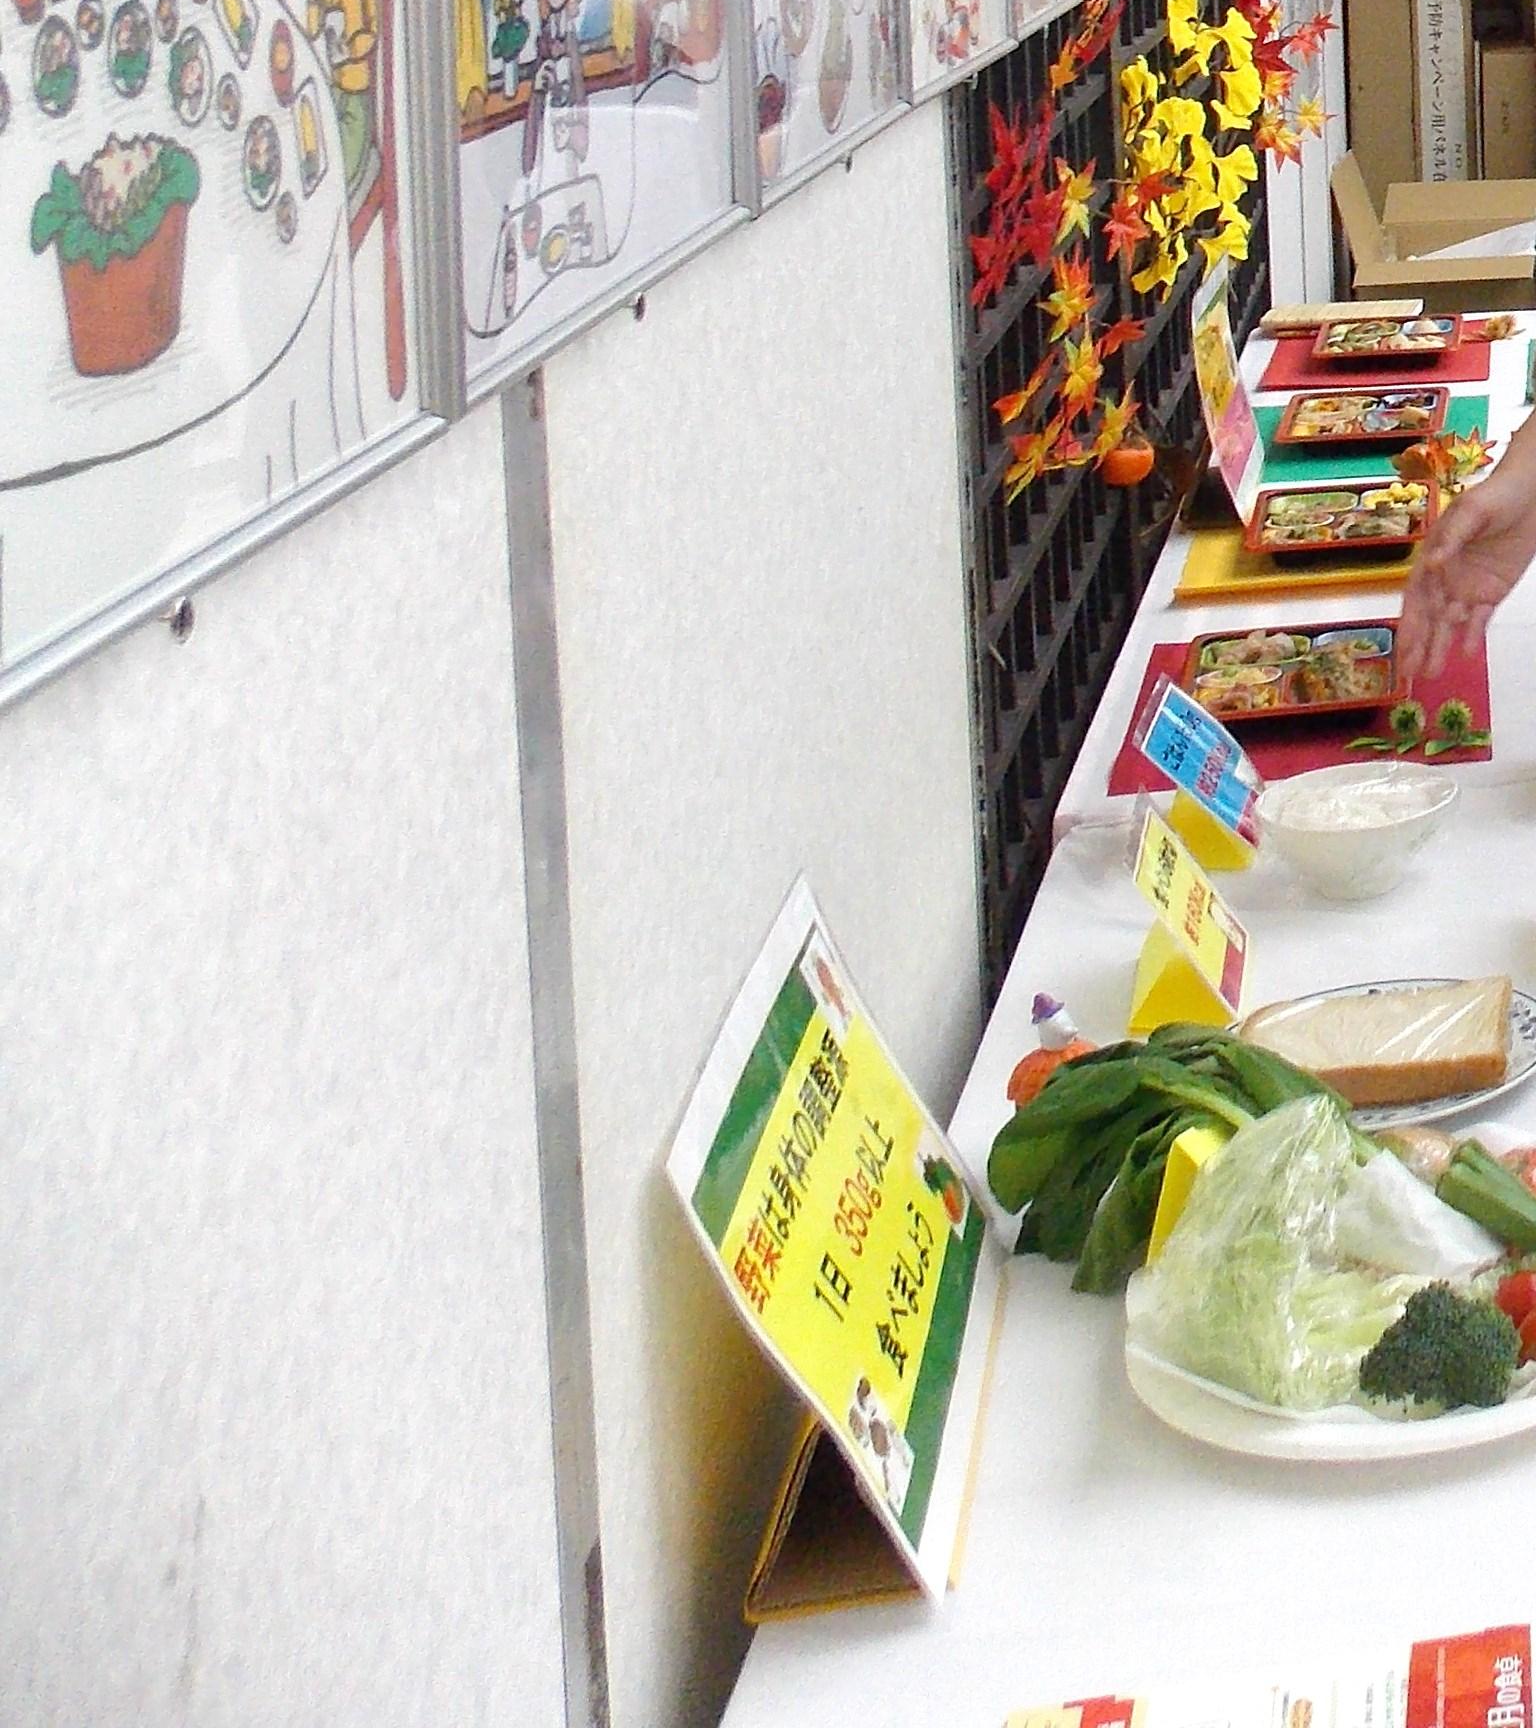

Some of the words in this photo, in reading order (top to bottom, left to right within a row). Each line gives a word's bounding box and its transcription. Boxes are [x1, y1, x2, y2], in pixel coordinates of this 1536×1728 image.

[734, 1027, 849, 1314] 野菜は身体の調整源
[814, 1252, 853, 1323] 1日
[834, 1115, 894, 1258] 350g以上
[876, 1201, 934, 1380] 食べましょう
[1486, 1653, 1526, 1728] 月の食卓
